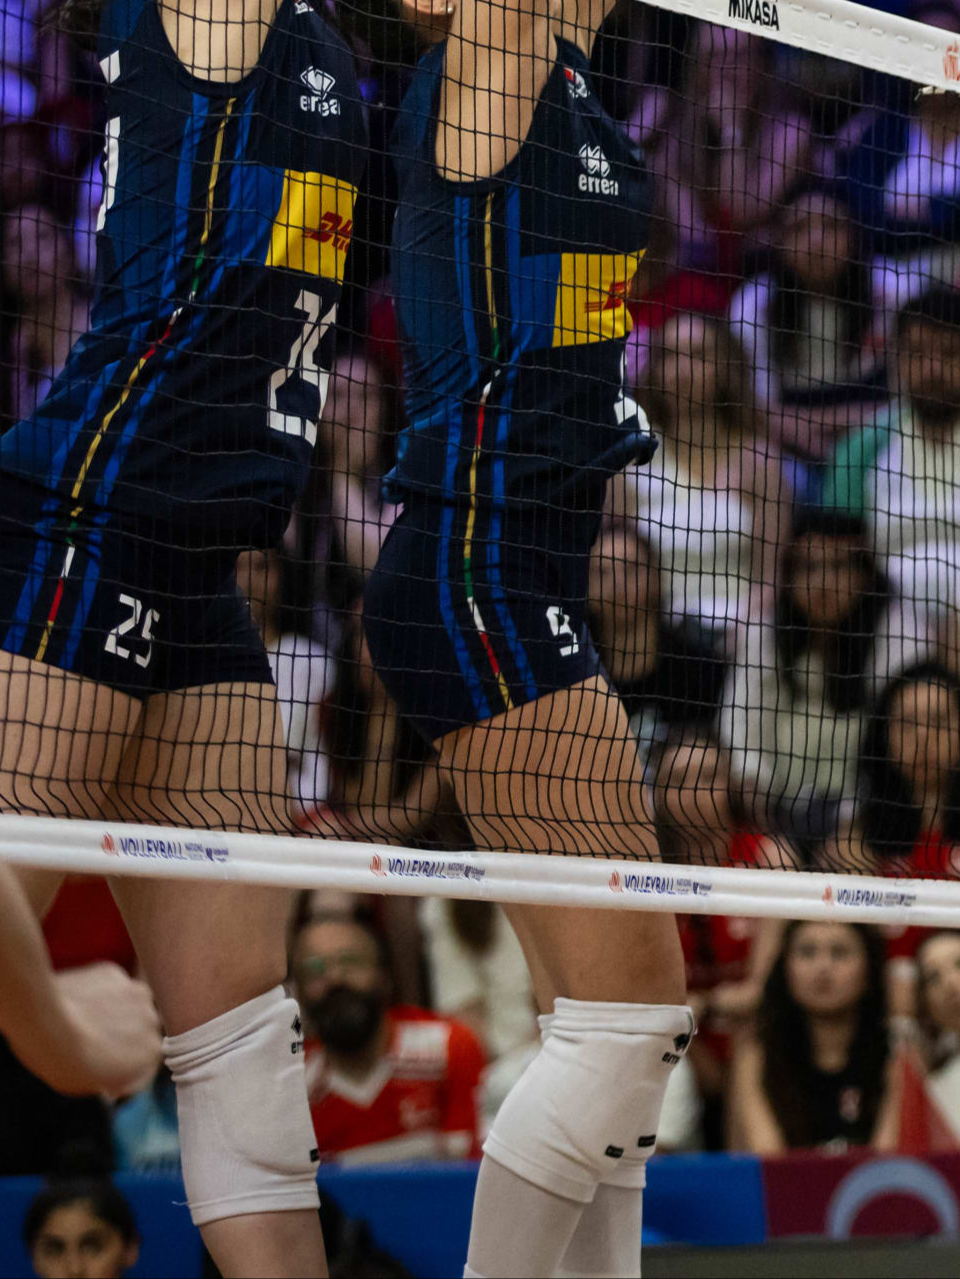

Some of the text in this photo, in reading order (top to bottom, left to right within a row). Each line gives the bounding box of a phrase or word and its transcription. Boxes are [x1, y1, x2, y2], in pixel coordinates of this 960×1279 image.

[104, 593, 160, 669] 25
[120, 837, 187, 860] VOLLEYBALL
[388, 857, 447, 879] VOLLEYBALL
[624, 873, 677, 895] VOLLEYBALL
